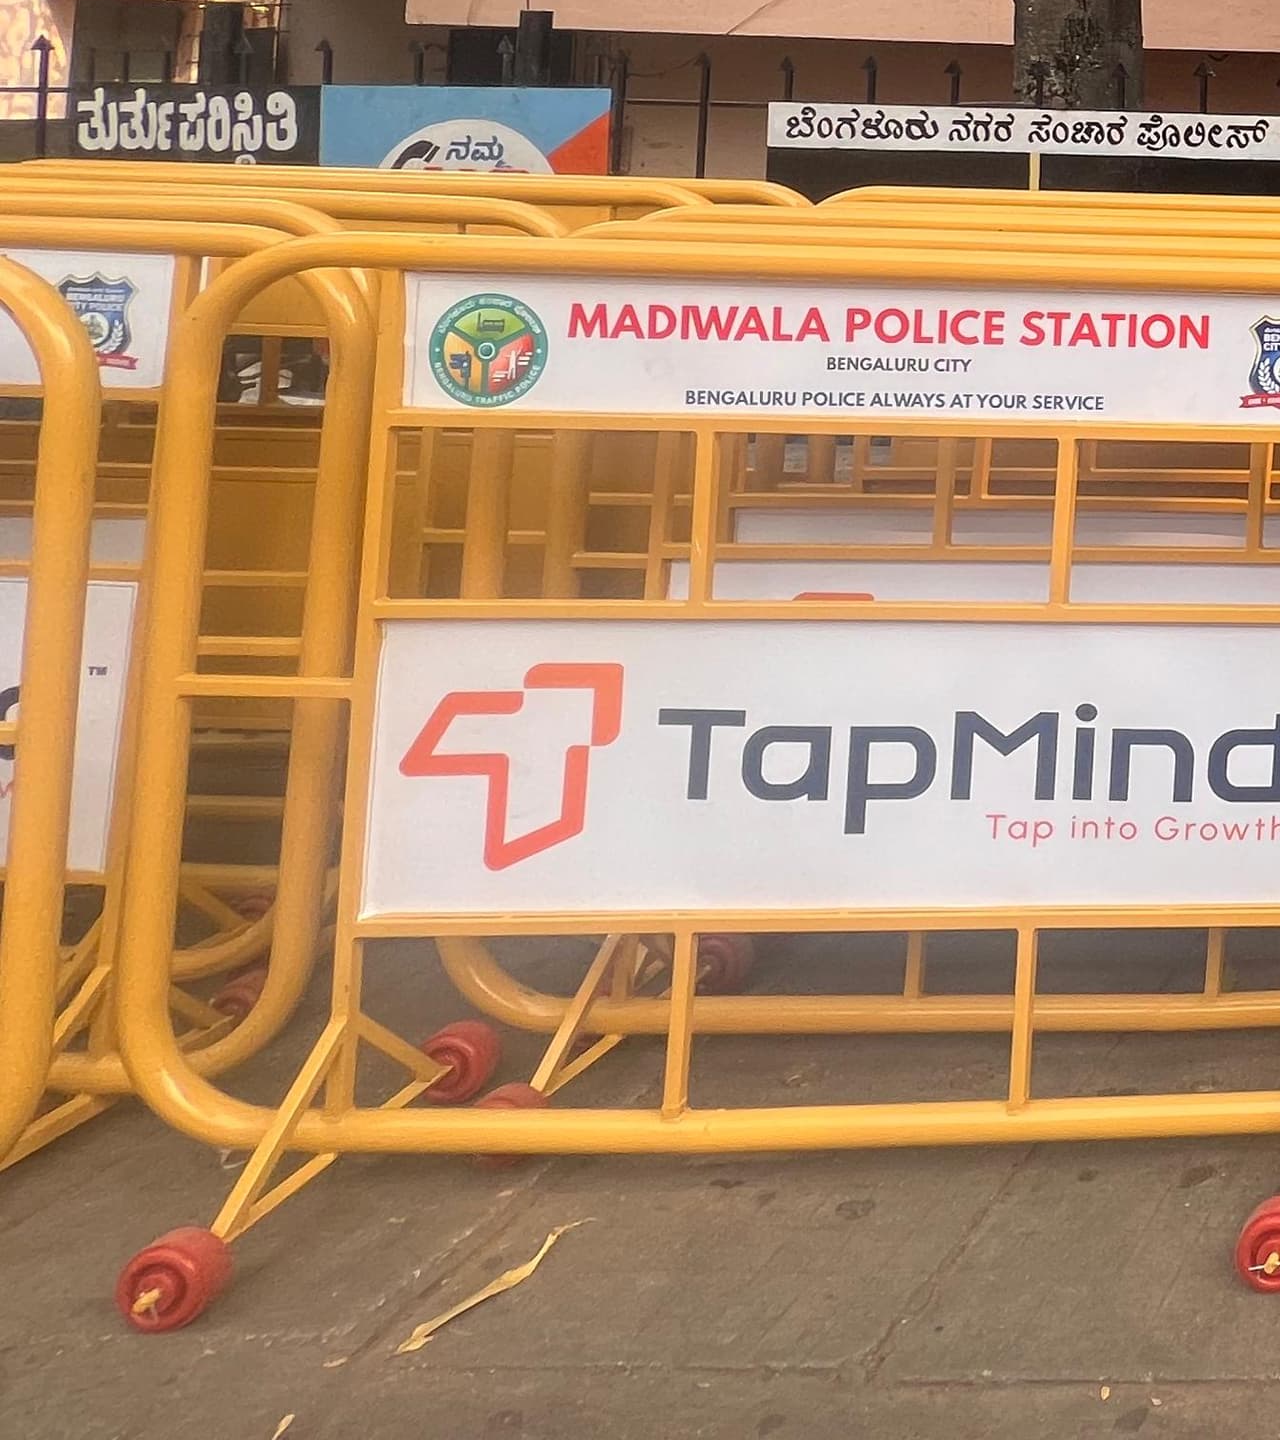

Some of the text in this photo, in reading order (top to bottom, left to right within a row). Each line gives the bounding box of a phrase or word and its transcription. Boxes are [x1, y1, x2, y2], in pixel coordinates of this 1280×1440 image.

[785, 105, 1271, 153] ಬೆಂಗಳೂರು ನಗರ ಸಂಚಾರ ಪೊಲೀಸ್
[445, 134, 512, 169] ನಮ್ಮ
[568, 302, 829, 343] MADIWALA
[845, 307, 1006, 346] POLICE
[1019, 310, 1210, 350] STATION
[826, 356, 973, 373] BENGALURU CITY
[685, 390, 1104, 411] BENGALURU POLICE ALWAYS AT YOUR SERVICE
[985, 814, 1054, 848] Tap
[1071, 815, 1138, 841] into
